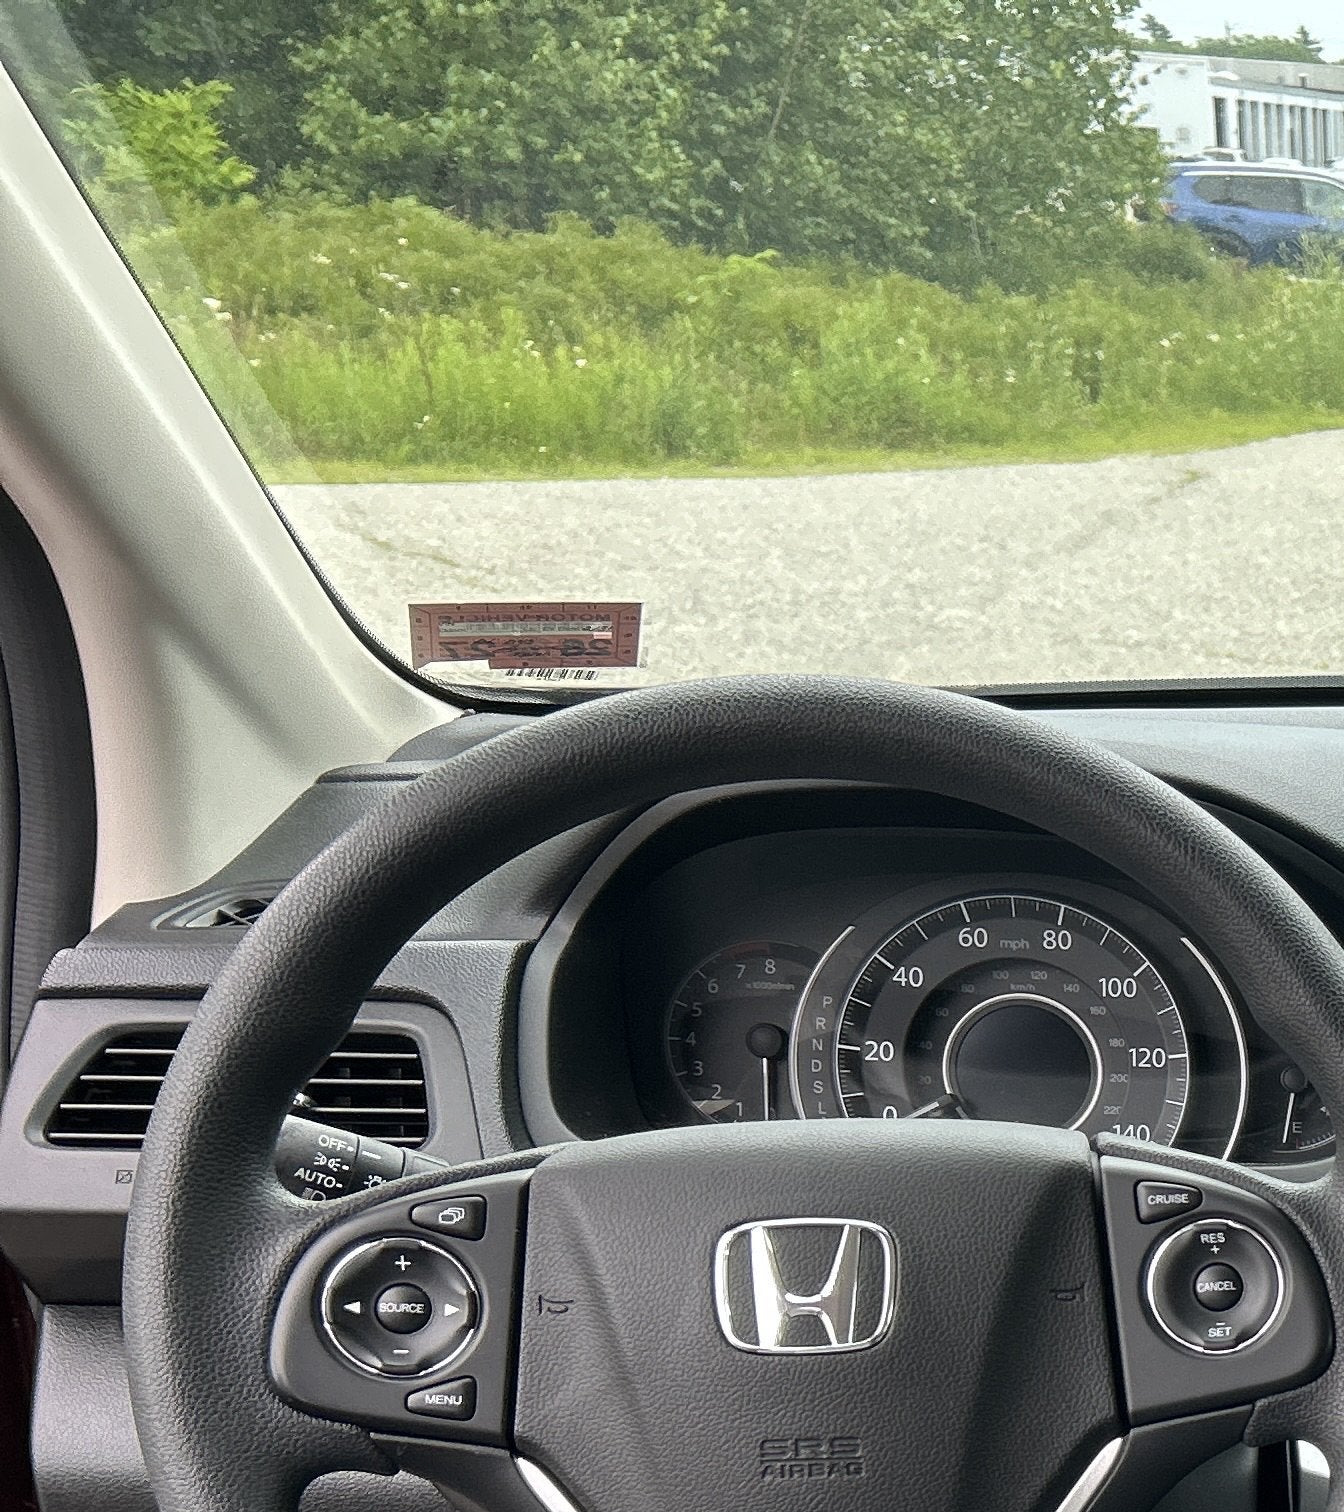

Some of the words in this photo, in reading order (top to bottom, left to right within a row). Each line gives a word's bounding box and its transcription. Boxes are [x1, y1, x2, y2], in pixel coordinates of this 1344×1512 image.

[959, 928, 988, 947] 60
[1000, 939, 1029, 950] mph
[1042, 930, 1072, 950] 80
[736, 964, 746, 979] 7
[764, 958, 776, 974] 8
[892, 967, 924, 988] 40
[1030, 971, 1047, 980] 120
[708, 979, 719, 994] 6
[1064, 984, 1080, 993] 140
[1099, 978, 1137, 998] 100
[692, 1002, 702, 1016] 5
[823, 996, 832, 1008] P
[816, 1017, 826, 1030] R
[685, 1032, 696, 1046] 4
[813, 1039, 822, 1050] N
[1109, 1038, 1125, 1048] 180
[864, 1041, 894, 1061] 20
[1129, 1048, 1166, 1068] 120
[693, 1061, 703, 1076] 3
[812, 1060, 822, 1072] D
[712, 1084, 722, 1099] 2
[813, 1081, 823, 1094] S
[736, 1102, 743, 1116] 1
[818, 1102, 827, 1114] L
[882, 1105, 898, 1119] 0
[1112, 1124, 1150, 1142] 140
[1292, 1122, 1302, 1133] E
[319, 1135, 348, 1151] OFF
[294, 1168, 336, 1188] AUTO
[1147, 1194, 1189, 1205] CRUISE
[1200, 1233, 1226, 1243] RES
[1197, 1281, 1236, 1292] CANCEL
[379, 1302, 424, 1314] SOURCE
[1208, 1326, 1232, 1337] SET
[425, 1394, 462, 1406] MENU
[760, 1436, 861, 1458] SRS
[760, 1462, 864, 1479] AIRBAG
